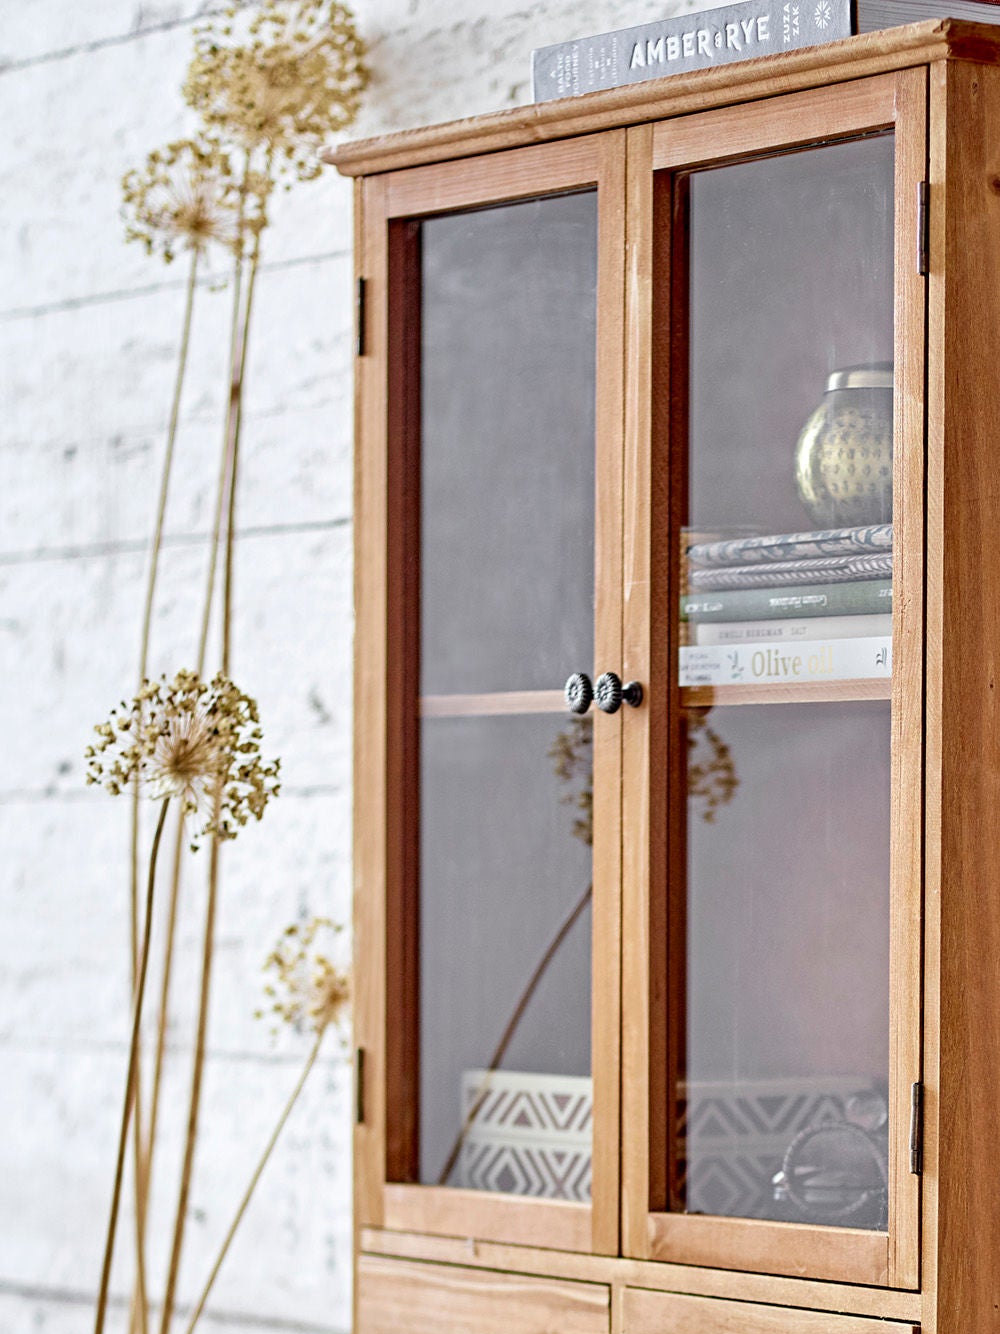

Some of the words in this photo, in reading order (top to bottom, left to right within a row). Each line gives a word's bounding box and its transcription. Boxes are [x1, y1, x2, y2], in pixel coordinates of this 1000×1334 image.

[783, 2, 791, 44] ZUZA
[792, 5, 800, 37] ZAK
[629, 28, 713, 69] AMBER
[725, 15, 771, 52] RYE
[564, 54, 572, 88] FOOD
[751, 648, 803, 677] Olive
[806, 645, 835, 675] oil
